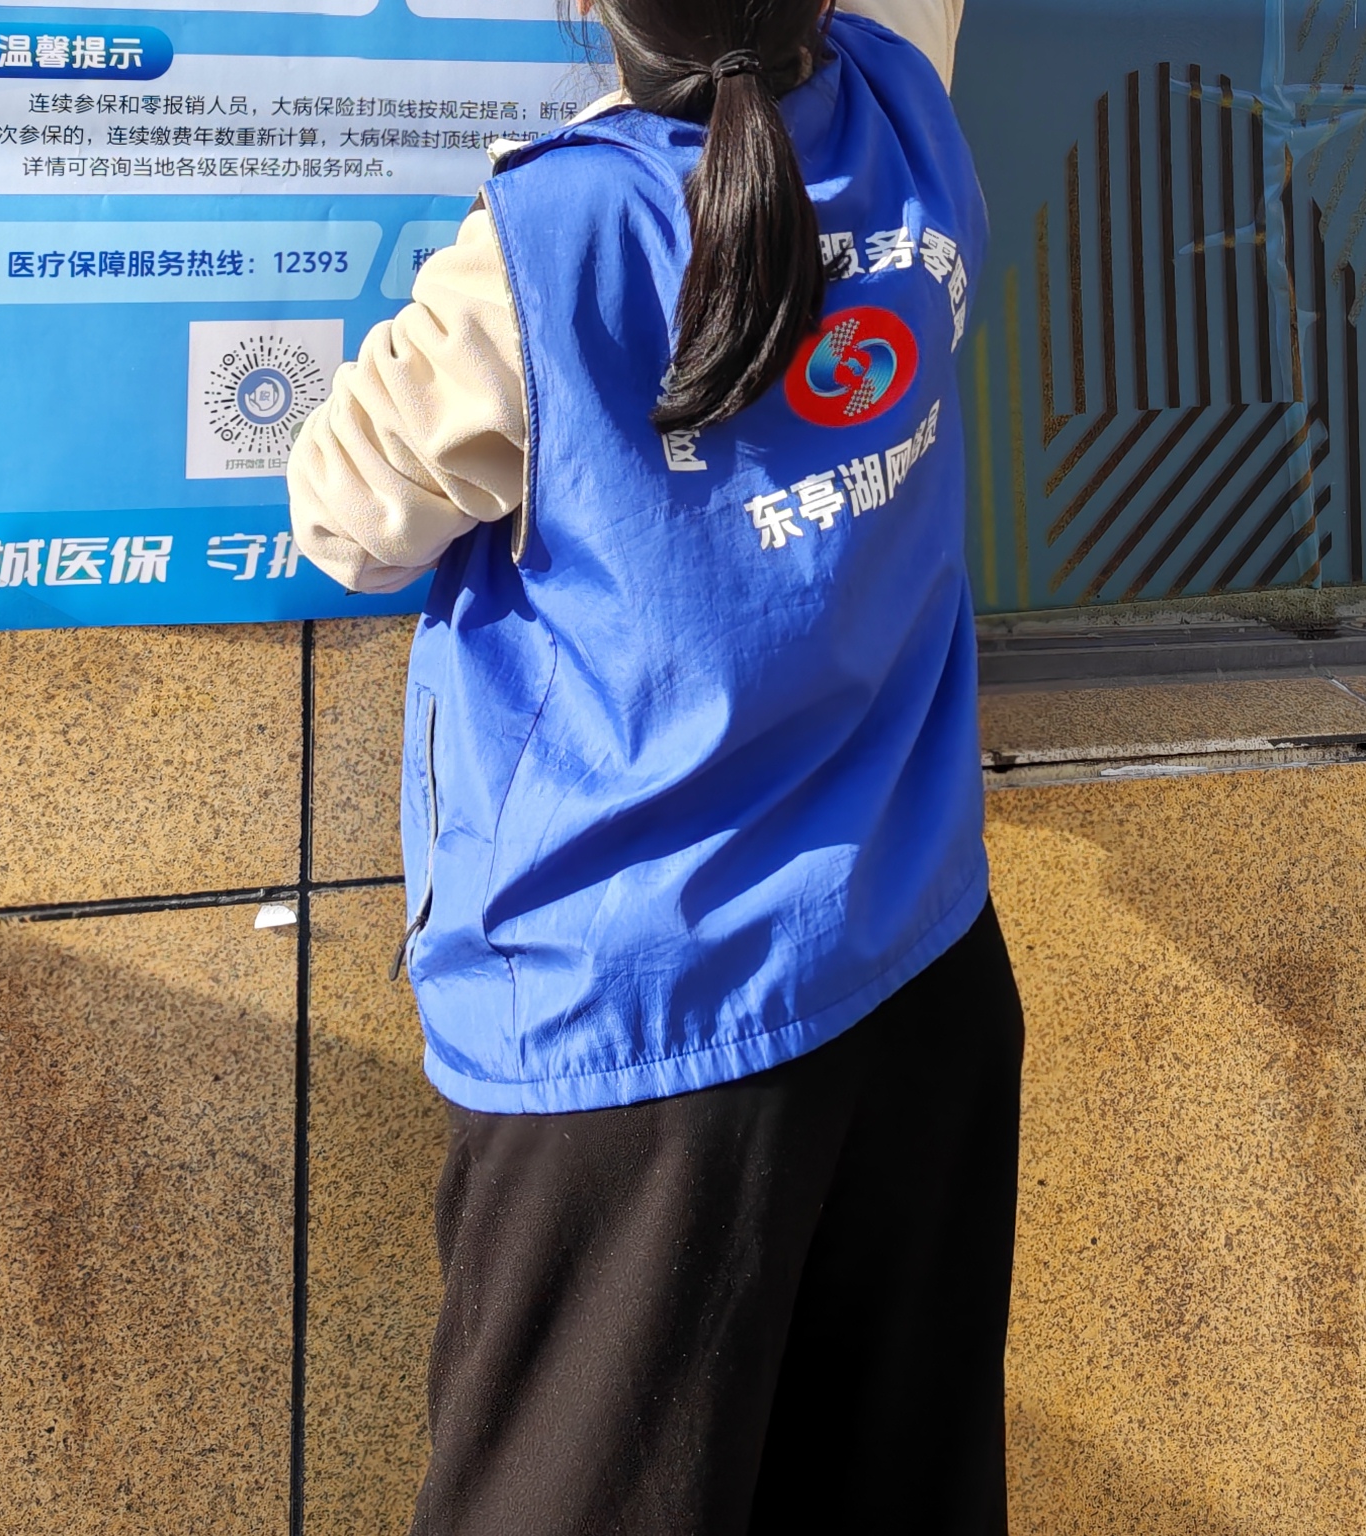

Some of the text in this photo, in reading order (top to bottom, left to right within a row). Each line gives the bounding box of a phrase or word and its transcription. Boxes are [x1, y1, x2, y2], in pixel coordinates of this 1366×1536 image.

[28, 93, 591, 121] 连续参保和零报销人员，大病保险封顶线按规定提高；断保
[22, 155, 395, 180] 详情可咨询当地各级医保经办服务网点。
[7, 249, 349, 279] 医疗保障服务热线：12393
